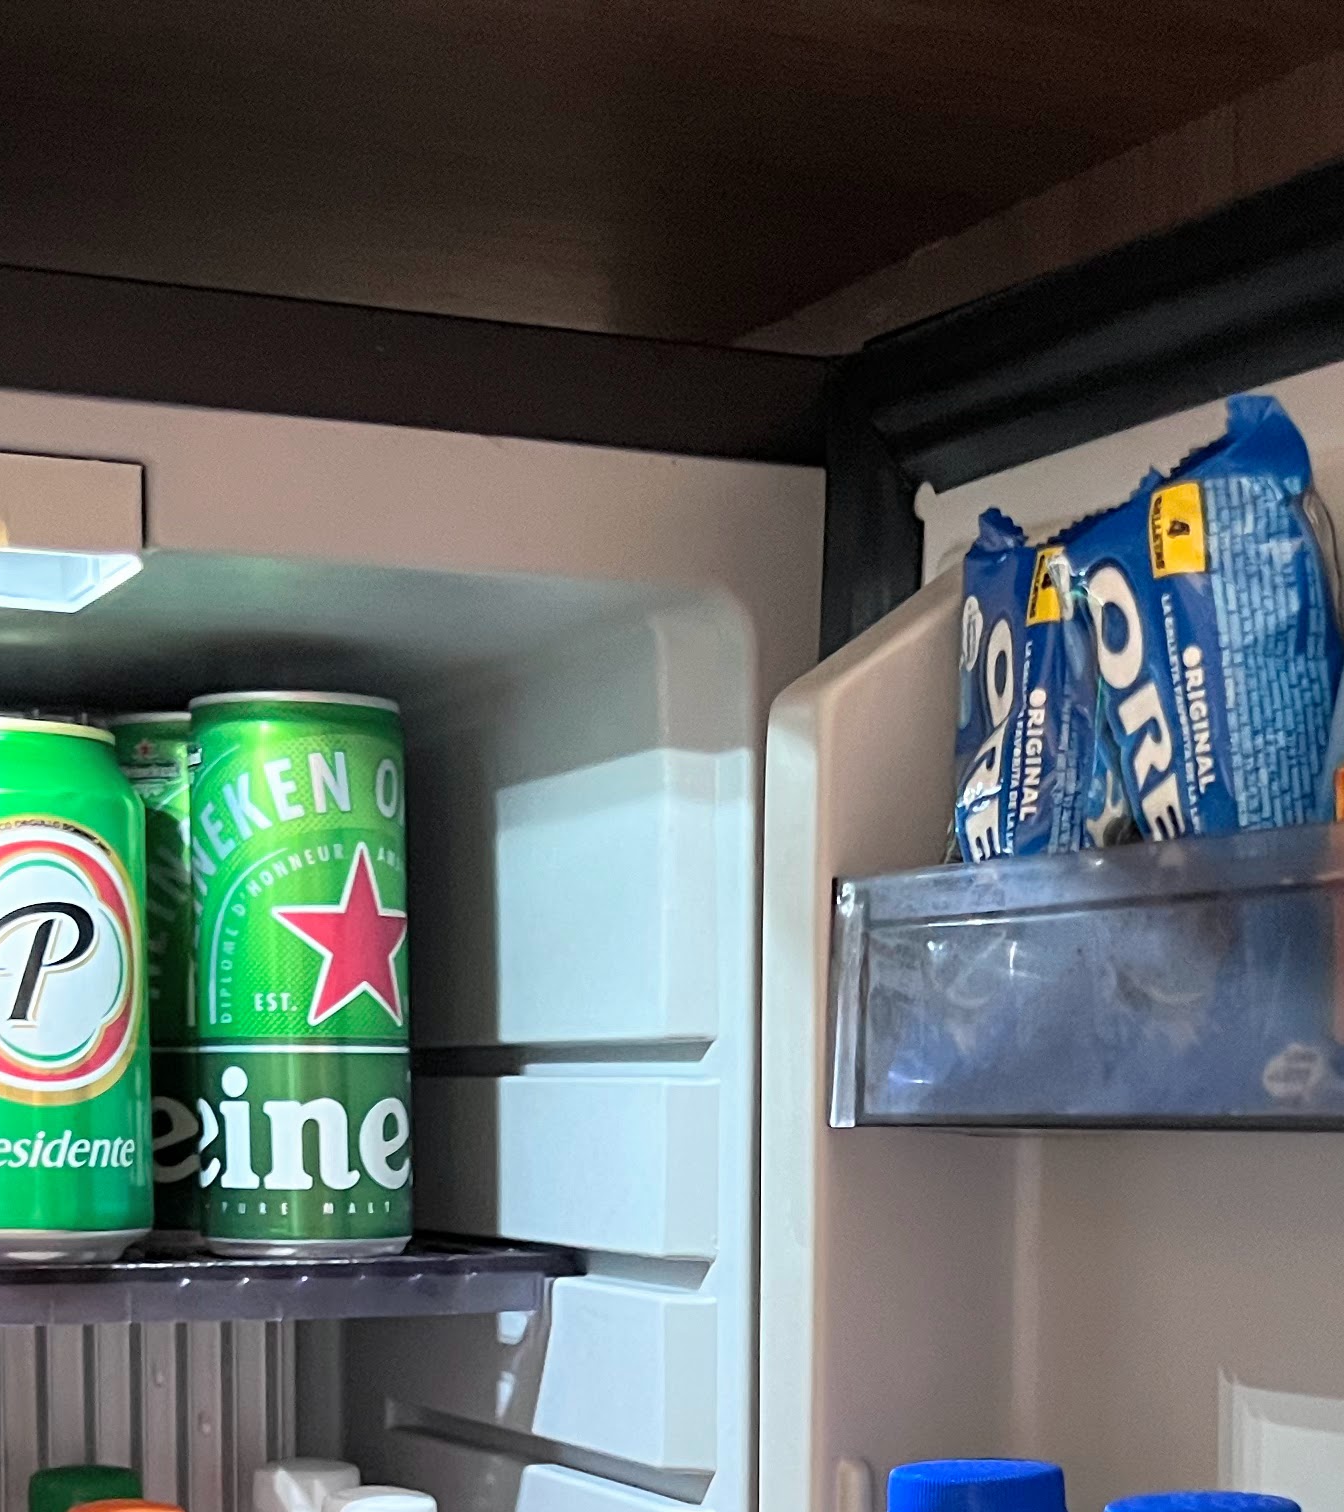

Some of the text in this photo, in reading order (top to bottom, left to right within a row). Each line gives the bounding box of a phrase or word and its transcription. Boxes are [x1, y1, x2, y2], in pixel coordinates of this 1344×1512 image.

[1019, 687, 1048, 821] ORIGINAL
[1182, 645, 1216, 794] ORIGINAL
[254, 993, 298, 1012] EST.
